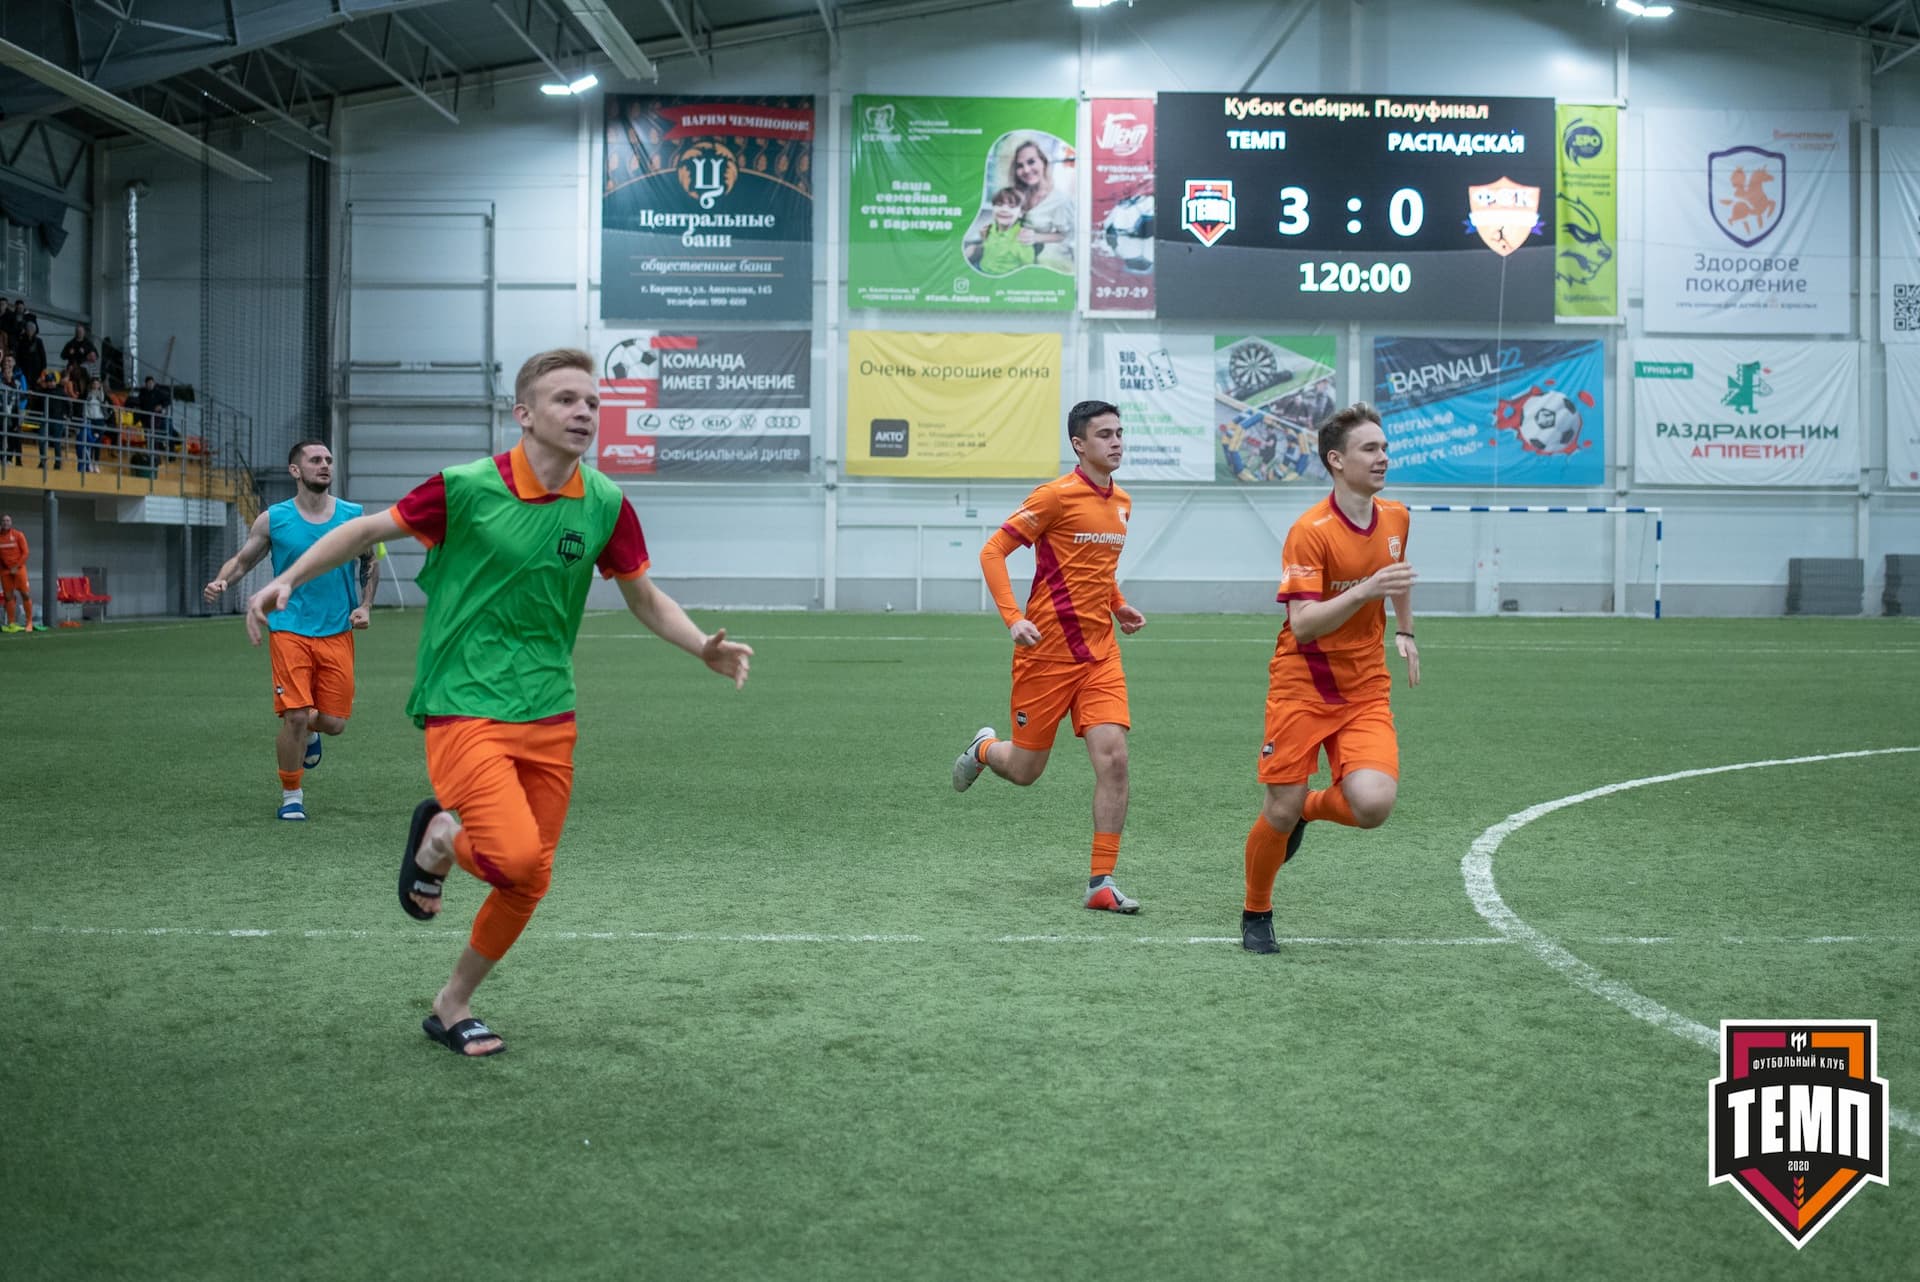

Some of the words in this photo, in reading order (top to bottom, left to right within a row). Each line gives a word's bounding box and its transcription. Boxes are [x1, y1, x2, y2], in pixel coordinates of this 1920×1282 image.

[1225, 97, 1286, 120] Кубок
[1289, 98, 1370, 121] Сибири.
[1375, 99, 1490, 123] Полуфинал
[682, 115, 727, 128] ПАРИМ
[1227, 130, 1287, 150] ТЕМП
[1388, 132, 1526, 156] РАСПАДСКАЯ
[861, 205, 962, 217] стоматология
[1278, 186, 1311, 235] 3
[1388, 187, 1424, 237] 0
[640, 210, 775, 234] Центральные
[682, 230, 732, 248] бани
[641, 258, 736, 274] общественные
[739, 258, 773, 273] бани
[1694, 252, 1800, 273] Здоровое
[1299, 262, 1412, 293] 120:00
[1686, 277, 1807, 293] поколение
[662, 353, 746, 371] КОМАНДА
[860, 360, 916, 377] Очень
[921, 364, 1002, 381] хорошие
[1008, 366, 1050, 379] окна
[662, 375, 713, 390] ИМЕЕТ
[716, 374, 796, 391] ЗНАЧЕНИЕ
[1656, 422, 1840, 441] РАЗДРАКОНИМ
[660, 446, 758, 462] ОФИЦИАЛЬНЫЙ
[760, 448, 801, 463] ДИЛЕР
[1691, 443, 1805, 459] АППЕТИТ!
